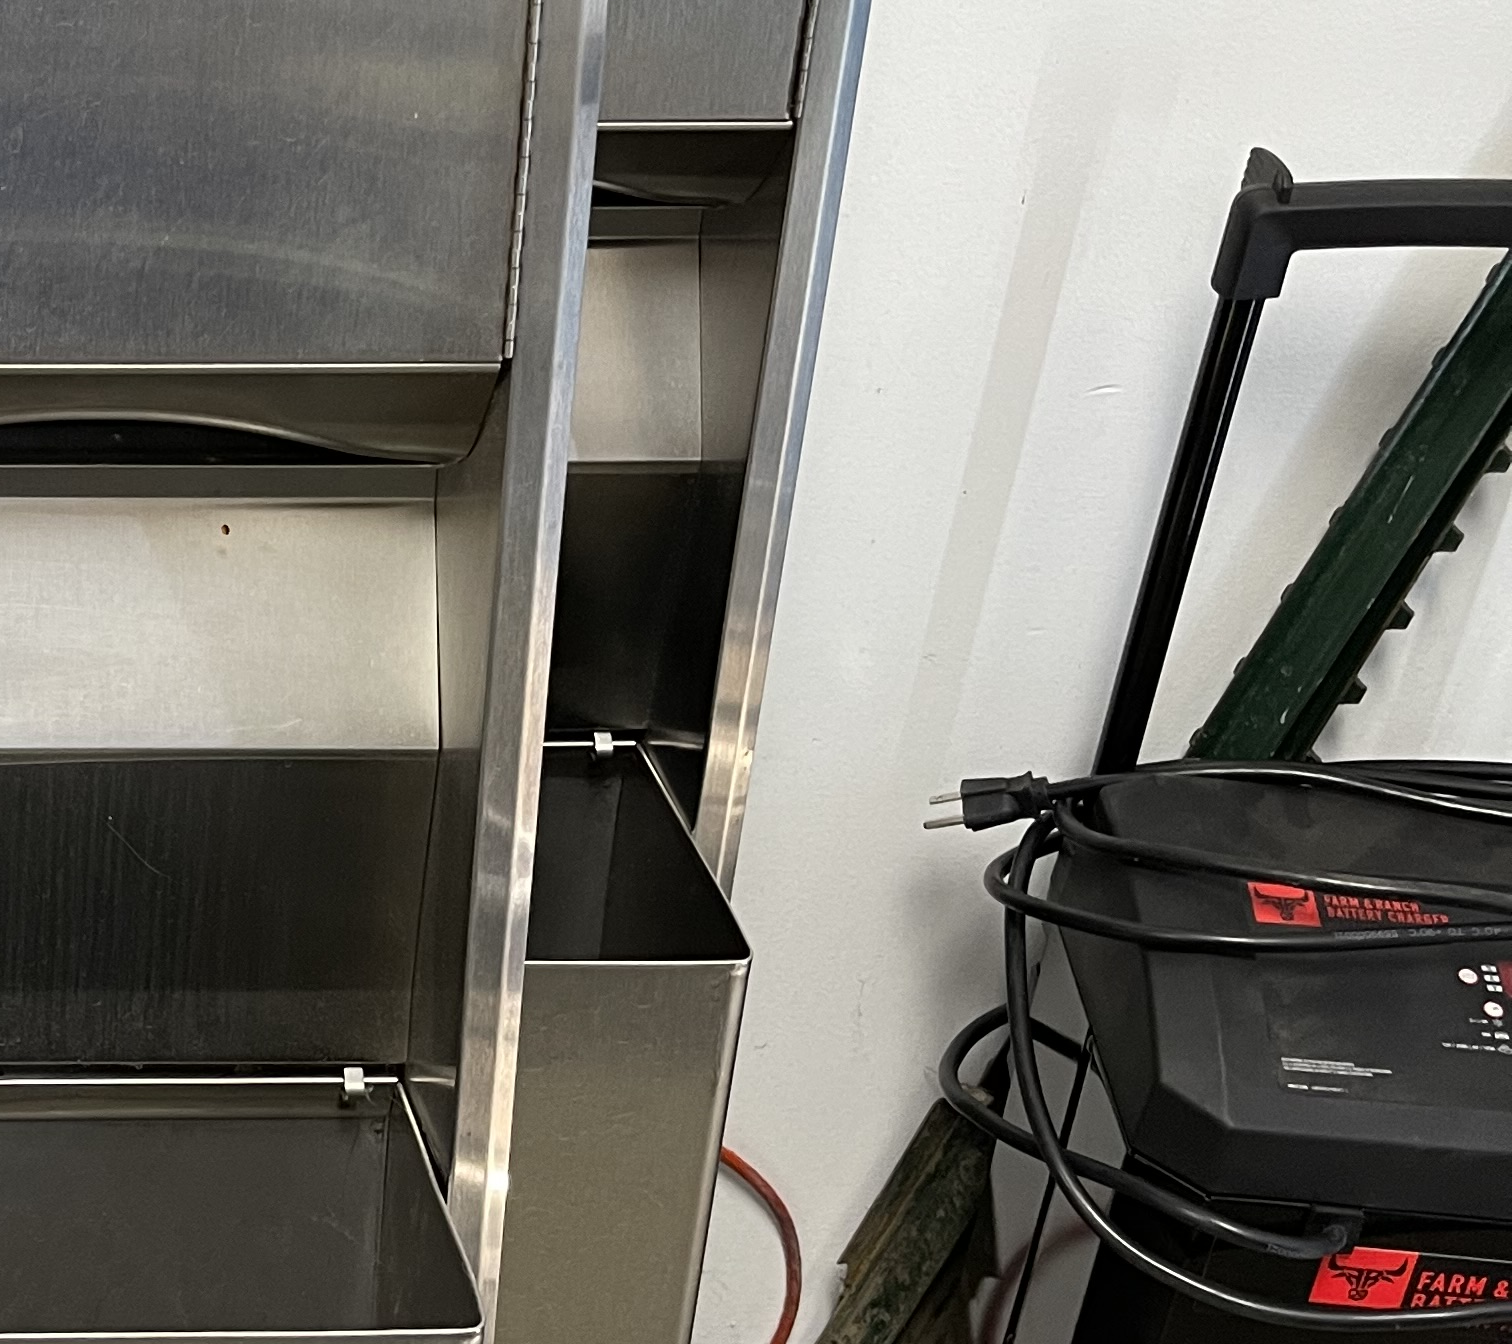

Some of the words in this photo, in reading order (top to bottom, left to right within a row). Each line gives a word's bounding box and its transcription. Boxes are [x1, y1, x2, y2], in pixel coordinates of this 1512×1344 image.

[1326, 907, 1383, 922] BATTERY
[1416, 1271, 1488, 1296] FARM
[1493, 1280, 1510, 1299] &
